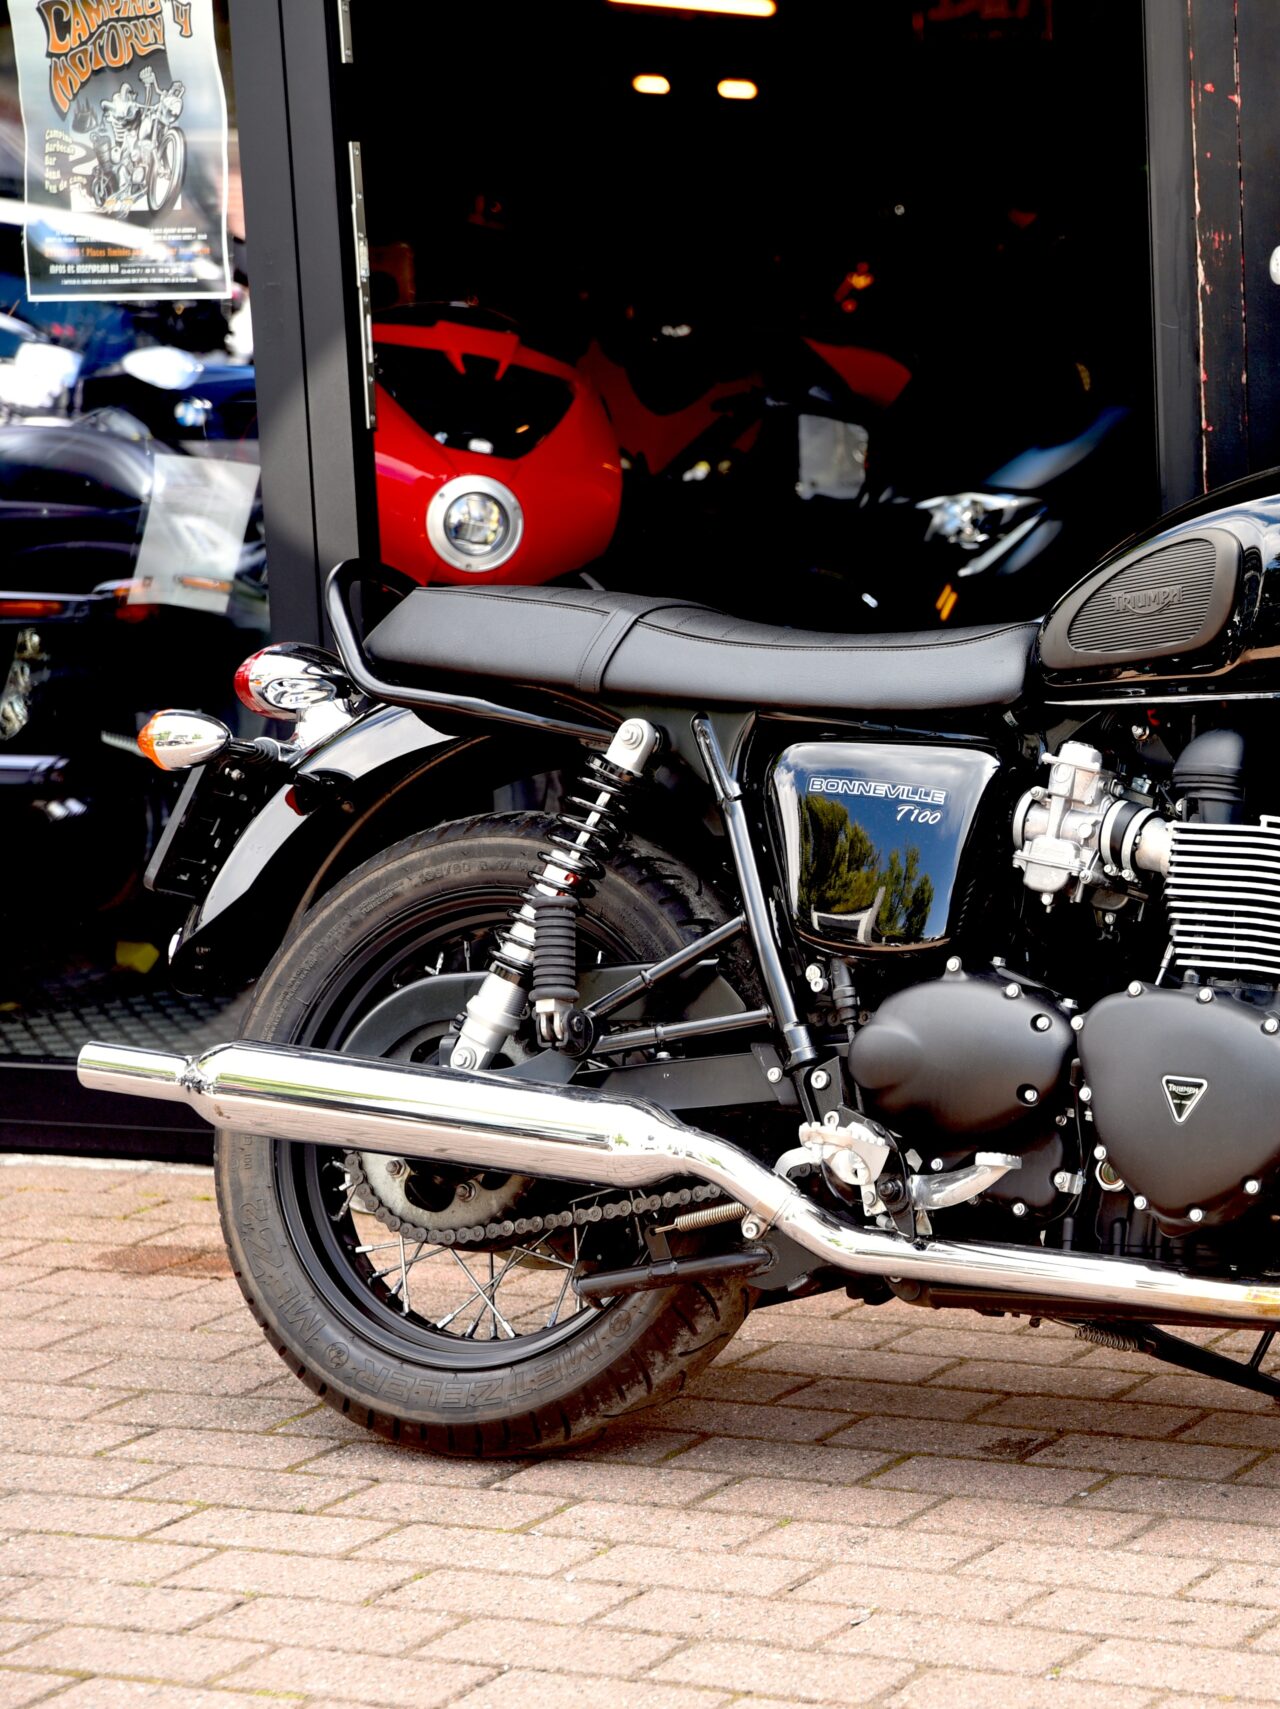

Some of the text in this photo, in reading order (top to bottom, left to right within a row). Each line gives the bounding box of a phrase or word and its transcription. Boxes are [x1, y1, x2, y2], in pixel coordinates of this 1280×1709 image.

[51, 14, 166, 113] MOTORUN
[1111, 585, 1182, 615] TRIUMPH
[809, 777, 946, 805] BONNEVILLE
[896, 805, 941, 824] T100
[1168, 1083, 1199, 1096] TRIUMPH
[355, 1332, 602, 1409] METZELER
